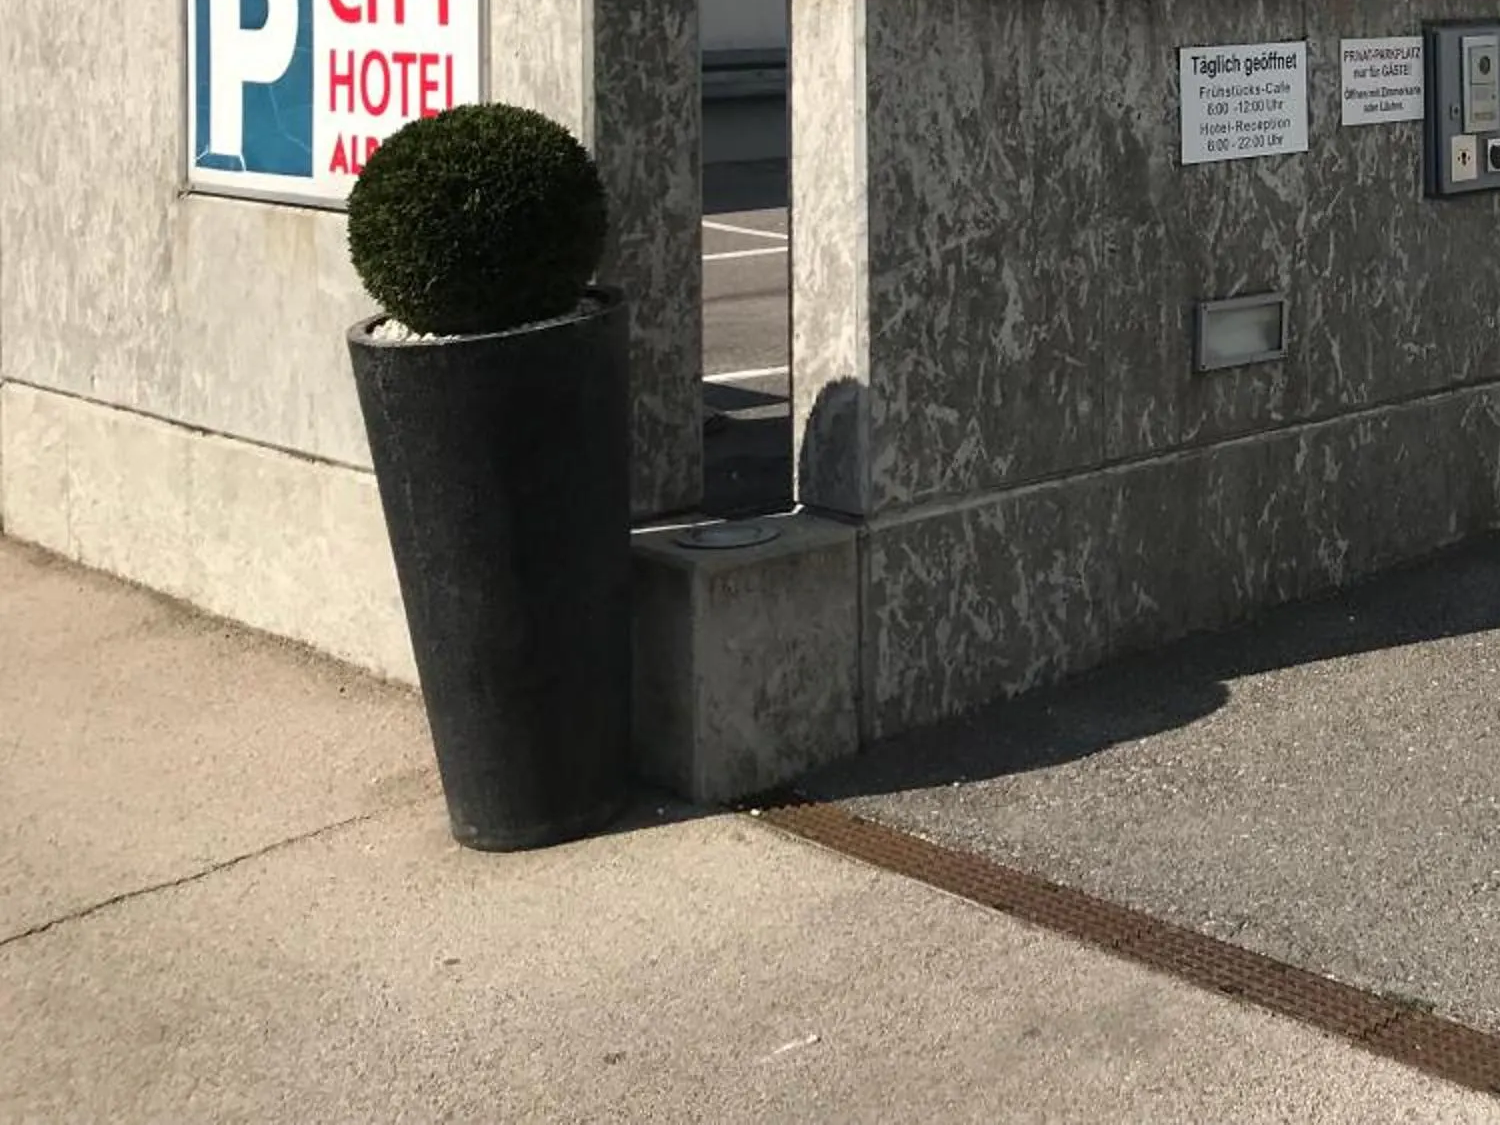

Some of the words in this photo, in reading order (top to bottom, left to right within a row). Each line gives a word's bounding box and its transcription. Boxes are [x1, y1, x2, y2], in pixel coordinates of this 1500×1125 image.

[1191, 54, 1241, 79] Täglich
[1244, 51, 1297, 77] geöffnet
[1266, 99, 1284, 112] Uhr
[1267, 134, 1284, 146] Uhr
